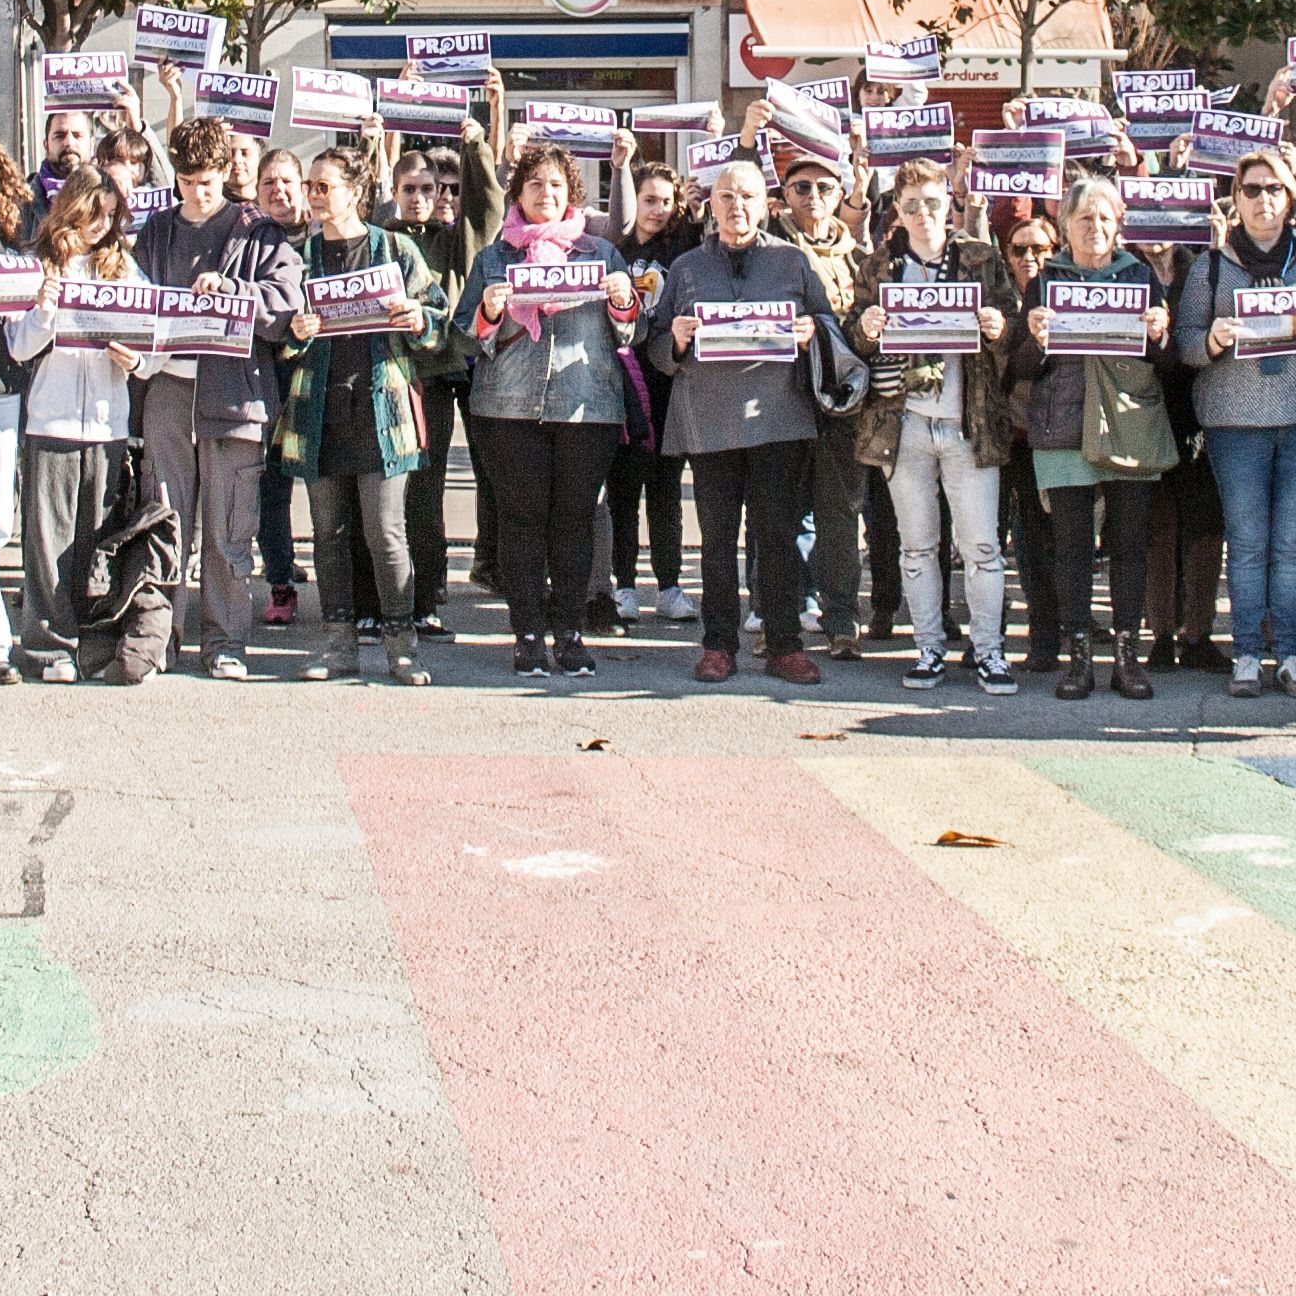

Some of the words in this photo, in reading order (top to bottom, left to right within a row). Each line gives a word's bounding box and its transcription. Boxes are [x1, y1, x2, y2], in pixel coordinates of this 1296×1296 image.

[141, 10, 205, 34] PROU!!
[413, 35, 485, 55] PROU!!
[49, 55, 123, 77] PROU!!
[199, 73, 271, 97] PROU!!
[1129, 95, 1206, 114] PROU!!
[869, 108, 945, 129] PROU!!
[1197, 113, 1275, 139] PROU!!
[1123, 181, 1206, 200] PROU!!
[515, 266, 599, 289] PROU!!
[64, 283, 153, 308] PROU!!
[162, 292, 249, 318] PROU!!
[888, 288, 973, 309] PROU!!
[1056, 287, 1142, 309] PROU!!
